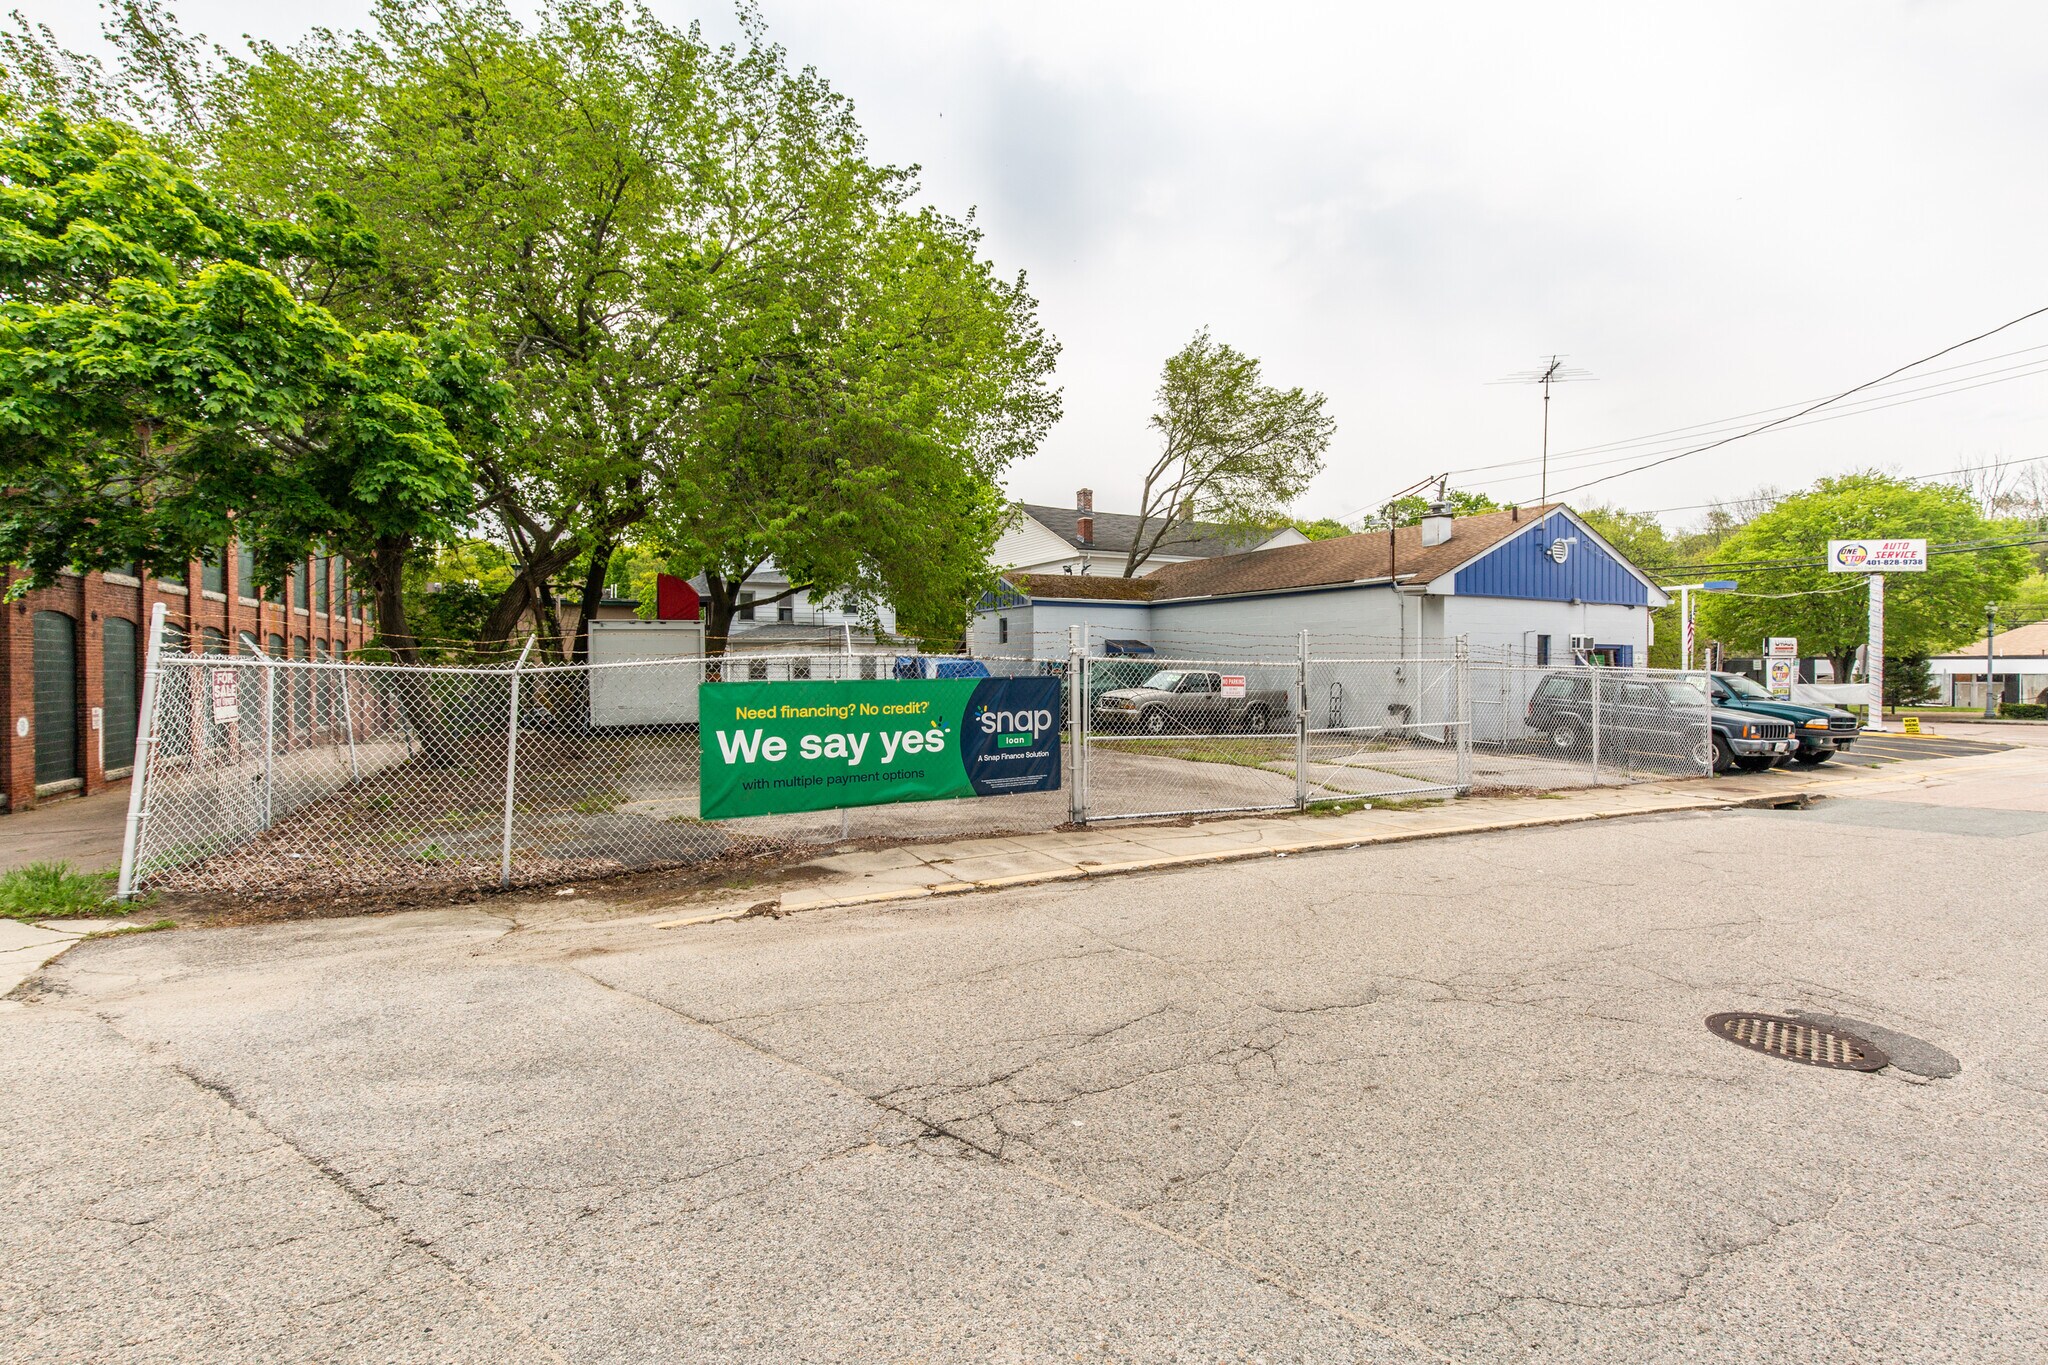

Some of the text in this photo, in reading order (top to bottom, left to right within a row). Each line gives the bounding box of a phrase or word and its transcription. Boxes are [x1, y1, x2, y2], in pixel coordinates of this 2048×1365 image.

[1882, 542, 1910, 550] AUTO
[1874, 550, 1918, 559] SERVICE
[216, 672, 234, 684] FOR
[214, 685, 237, 698] SALE
[735, 706, 777, 720] Need
[780, 703, 857, 720] financing?
[859, 703, 879, 716] No
[981, 709, 1052, 740] snap
[716, 728, 945, 766] We say yes
[1005, 737, 1025, 745] loan
[983, 754, 1001, 762] Snap
[1001, 752, 1025, 760] Finance
[1025, 751, 1050, 759] Solution
[742, 768, 925, 791] with multiple payment options
